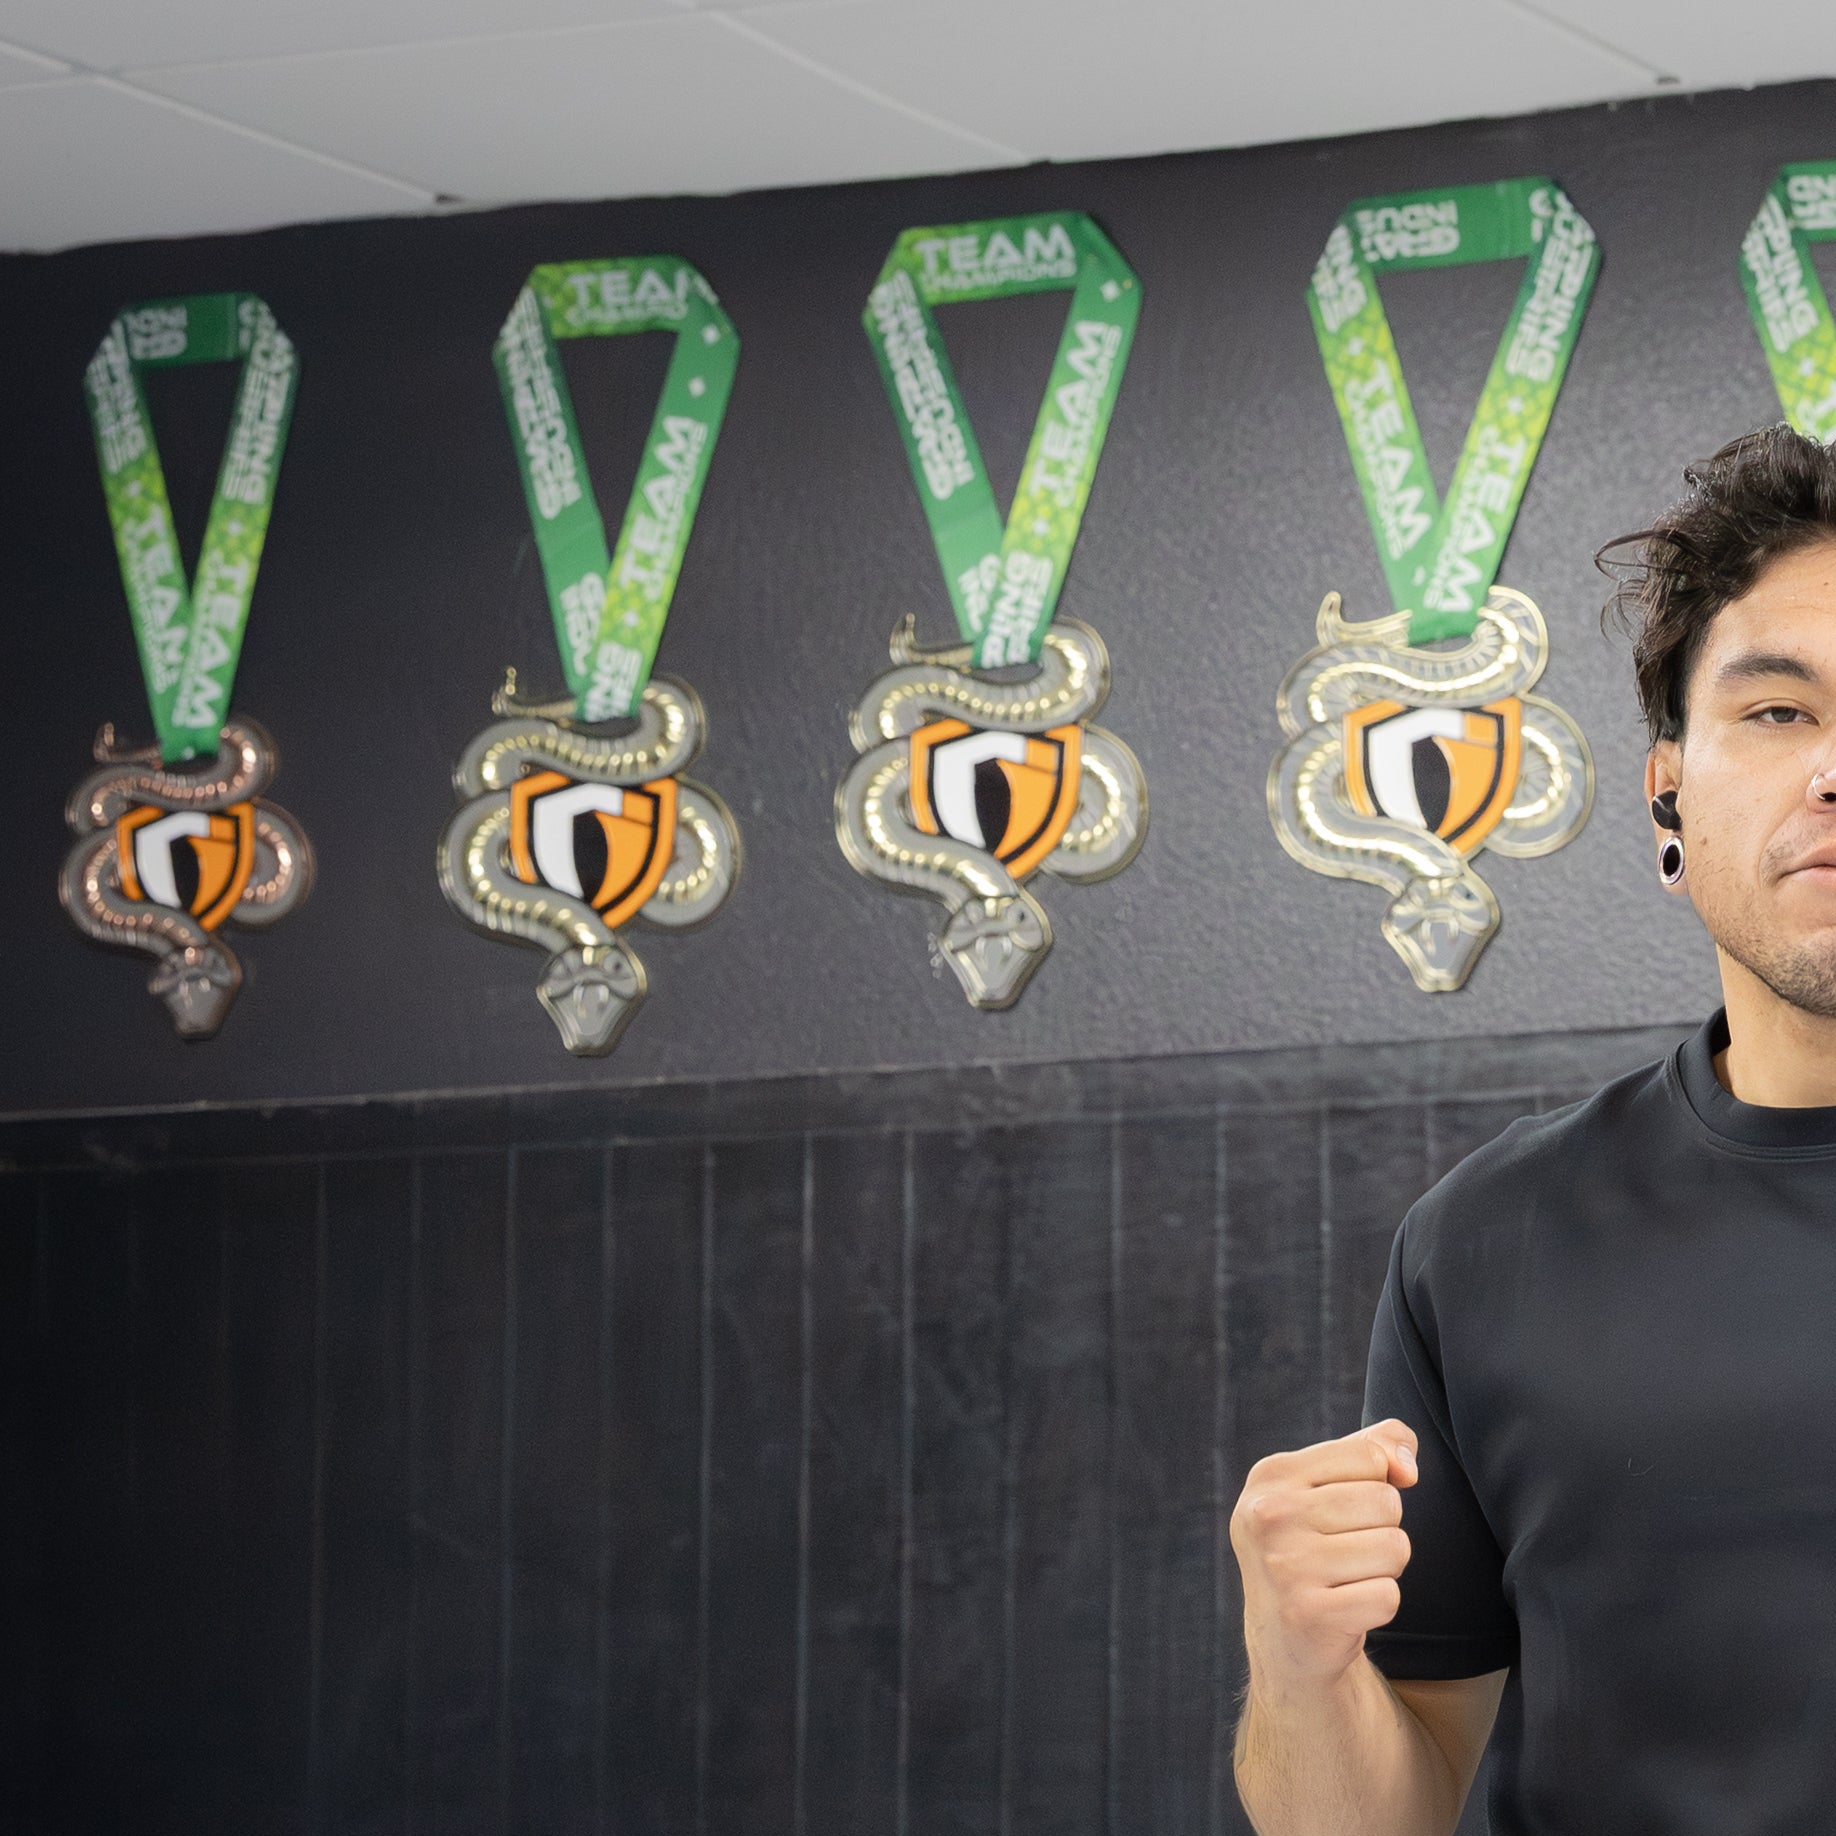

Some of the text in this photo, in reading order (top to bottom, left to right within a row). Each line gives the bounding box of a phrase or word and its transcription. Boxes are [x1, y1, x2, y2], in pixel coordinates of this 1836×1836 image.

[913, 223, 1077, 278] TEAM
[1030, 320, 1108, 498] TEAM
[1363, 358, 1432, 552] TEAM
[620, 415, 695, 588] TEAM
[1437, 436, 1527, 612] TEAM
[186, 556, 249, 728] TEAM
